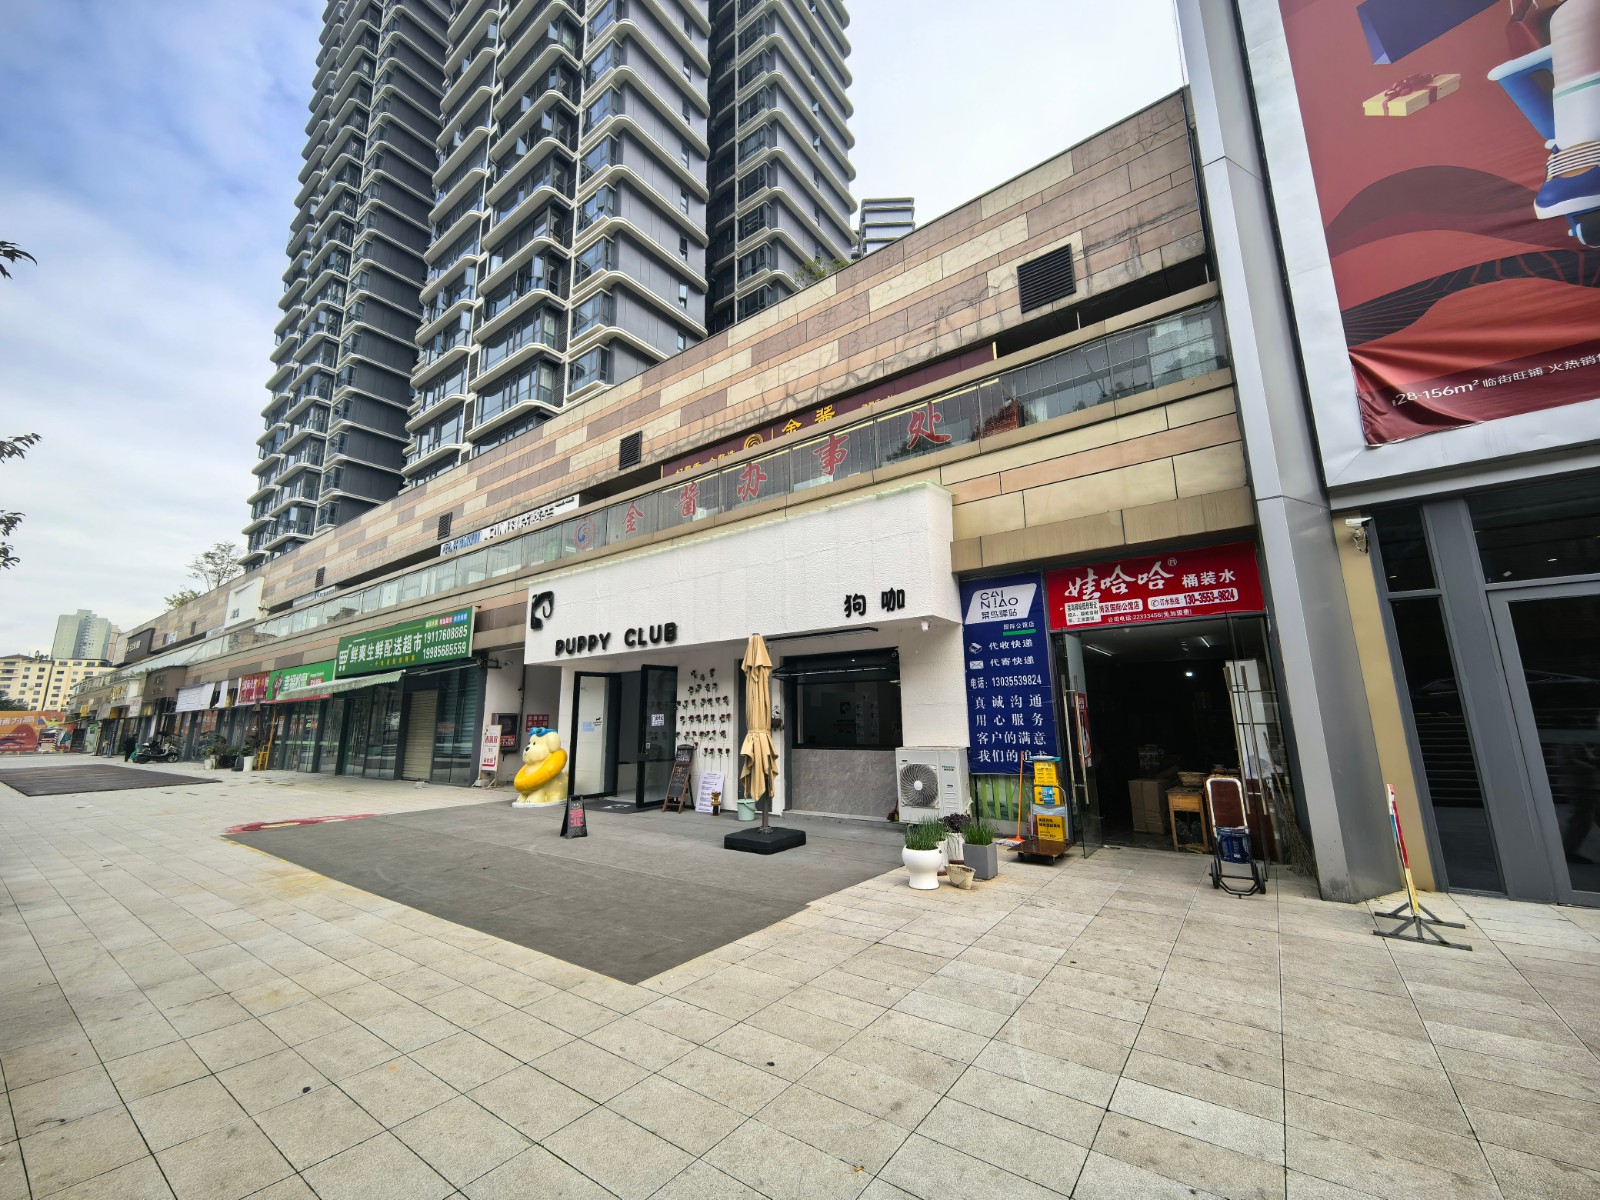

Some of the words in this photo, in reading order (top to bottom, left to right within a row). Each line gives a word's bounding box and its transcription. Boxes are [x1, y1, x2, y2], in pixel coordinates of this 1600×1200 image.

[1482, 367, 1543, 388] 临街旺铺
[1064, 561, 1175, 600] 娃哈哈
[1182, 568, 1236, 589] 桶装水
[844, 587, 905, 618] 狗咖
[980, 590, 1004, 601] CAI
[1184, 588, 1235, 606] 130-3553-9824
[424, 625, 468, 644] 19117608885
[555, 632, 611, 656] PUPPY
[624, 622, 679, 647] CLUB
[423, 641, 467, 660] 19985685559
[988, 639, 1033, 650] 代收快递
[990, 656, 1034, 667] 代寄快递
[992, 674, 1042, 687] 13035539824
[975, 694, 1043, 709] 真诚沟通
[976, 713, 1044, 726] 用心服务
[976, 731, 1047, 745] 客户的满意
